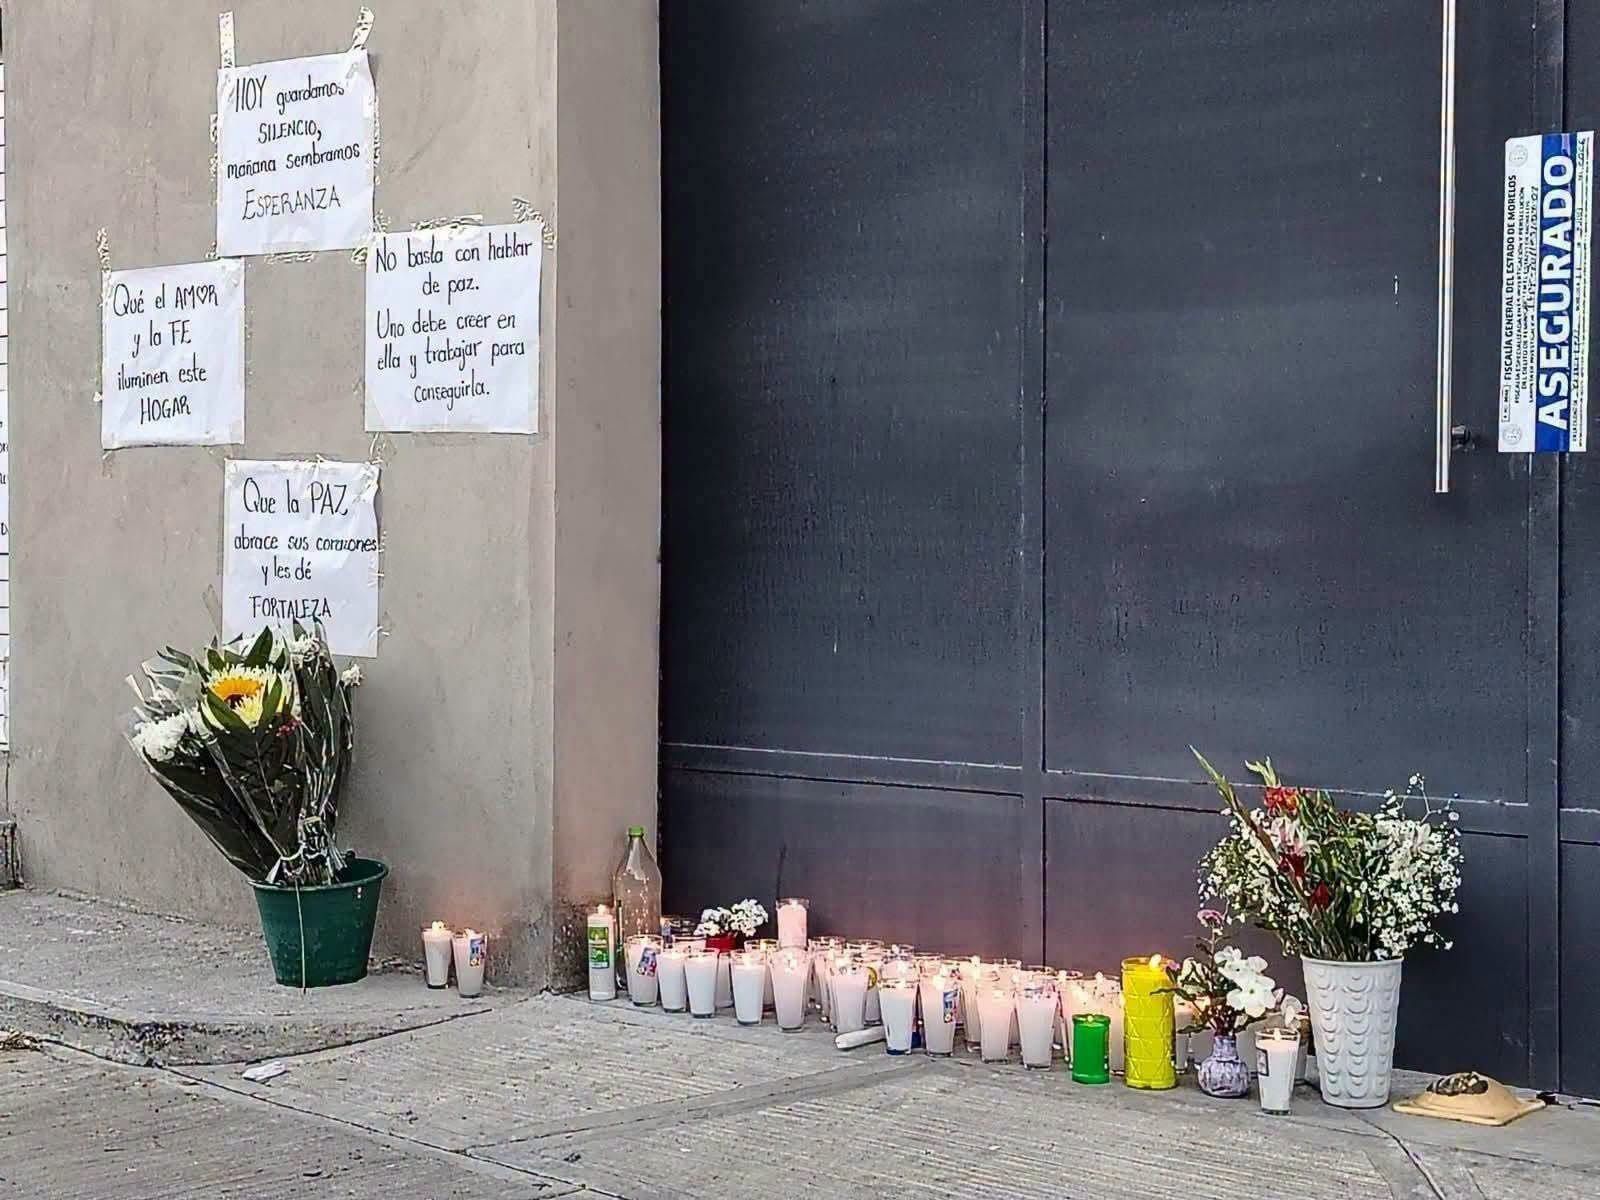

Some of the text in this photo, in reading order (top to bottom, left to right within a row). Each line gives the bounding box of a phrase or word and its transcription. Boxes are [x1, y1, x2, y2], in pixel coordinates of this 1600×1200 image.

[235, 74, 345, 115] HOY guardamos
[258, 119, 322, 144] SILENCIO,
[227, 159, 276, 179] mañana
[242, 184, 341, 220] ESPERANZA
[1507, 174, 1516, 220] MORELOS
[1506, 222, 1515, 234] DE
[375, 231, 533, 273] No basta con hablar
[1506, 236, 1514, 273] ESTADO
[113, 283, 145, 317] Qué
[155, 282, 166, 309] el
[422, 271, 480, 306] de paz.
[1505, 275, 1513, 292] DEL
[1538, 155, 1574, 431] ASEGURADO
[377, 308, 516, 340] Uno debe creer en
[1504, 295, 1513, 337] GENERAL
[131, 319, 192, 359] y la FE
[117, 352, 207, 391] iluminen este
[377, 336, 525, 380] ella y trabajar para
[1503, 339, 1512, 379] FISCALÍA
[140, 395, 192, 425] HOGAR
[243, 477, 349, 516] Que la PAZ
[234, 523, 377, 552] abrace sus corazones
[261, 554, 312, 586] y les dé
[249, 595, 332, 619] FORTALEZA
